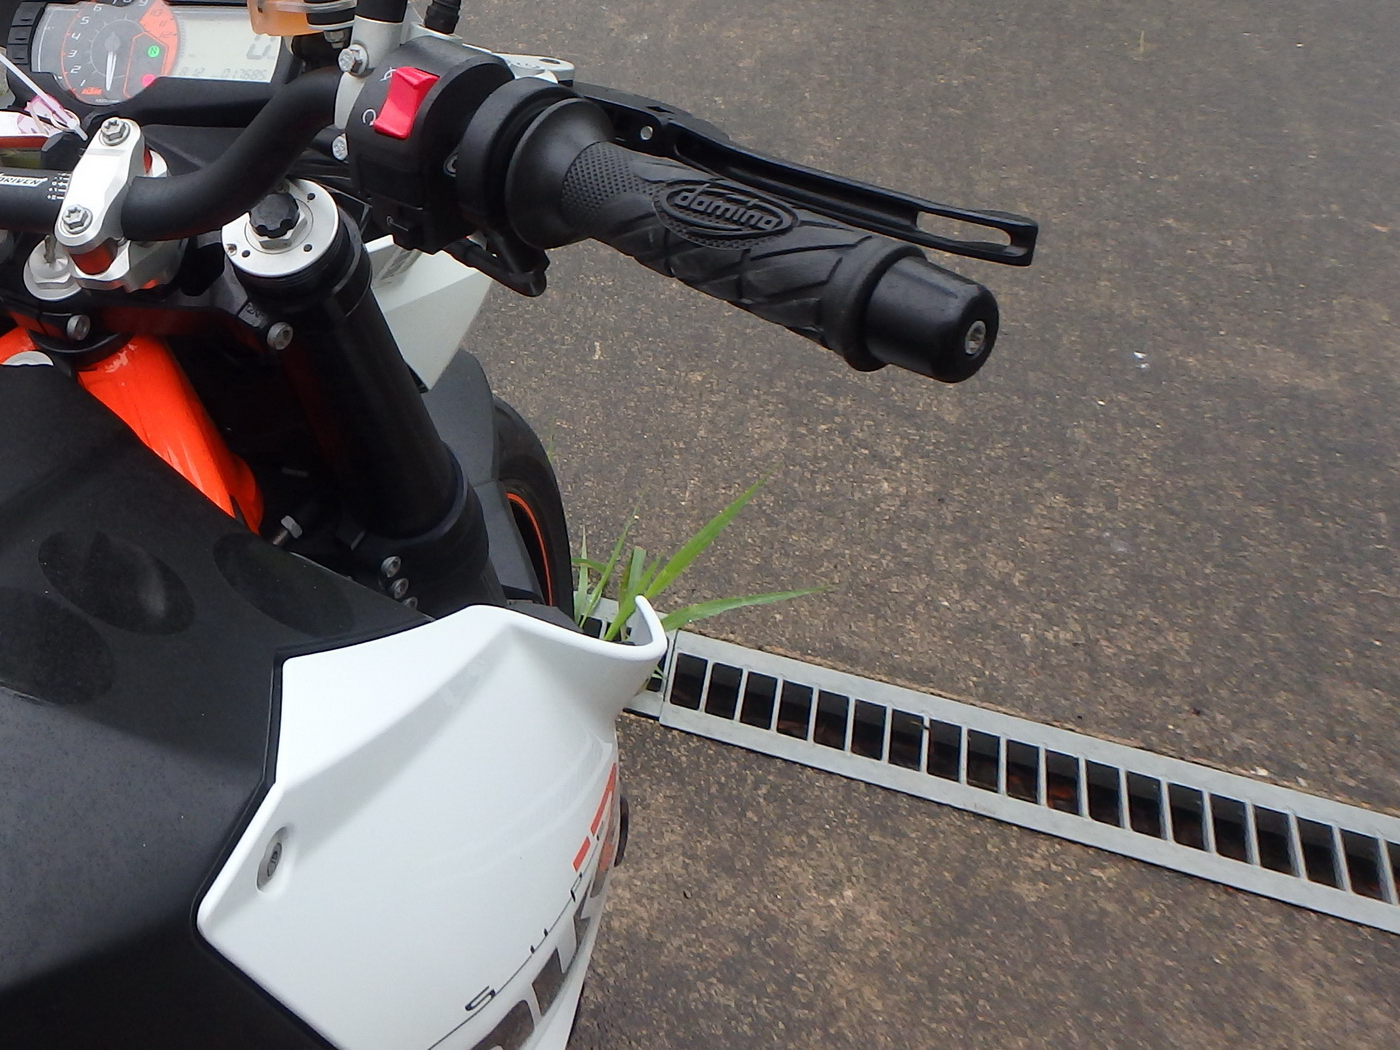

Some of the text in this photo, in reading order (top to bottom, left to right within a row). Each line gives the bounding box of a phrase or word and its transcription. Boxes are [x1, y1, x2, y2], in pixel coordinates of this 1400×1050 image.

[93, 3, 104, 12] 6
[80, 16, 91, 25] 5
[71, 32, 82, 40] 4
[67, 49, 78, 58] 3
[70, 65, 82, 74] 2
[673, 183, 783, 231] domino
